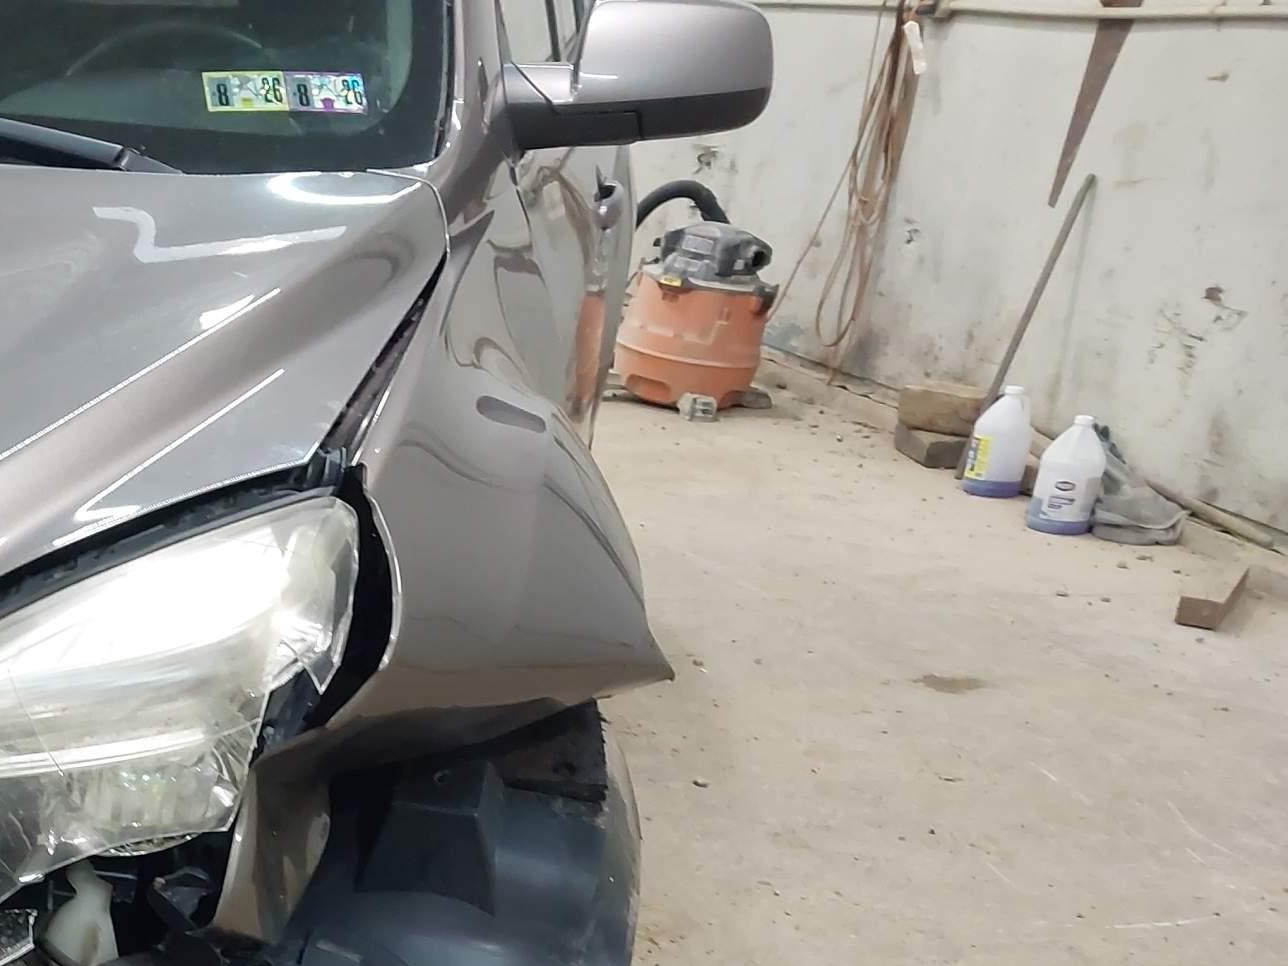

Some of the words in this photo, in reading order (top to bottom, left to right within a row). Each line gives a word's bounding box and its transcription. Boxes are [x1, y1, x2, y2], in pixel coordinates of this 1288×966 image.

[216, 83, 229, 106] 8
[261, 77, 283, 103] 26
[297, 83, 310, 107] 8
[340, 79, 363, 105] 26
